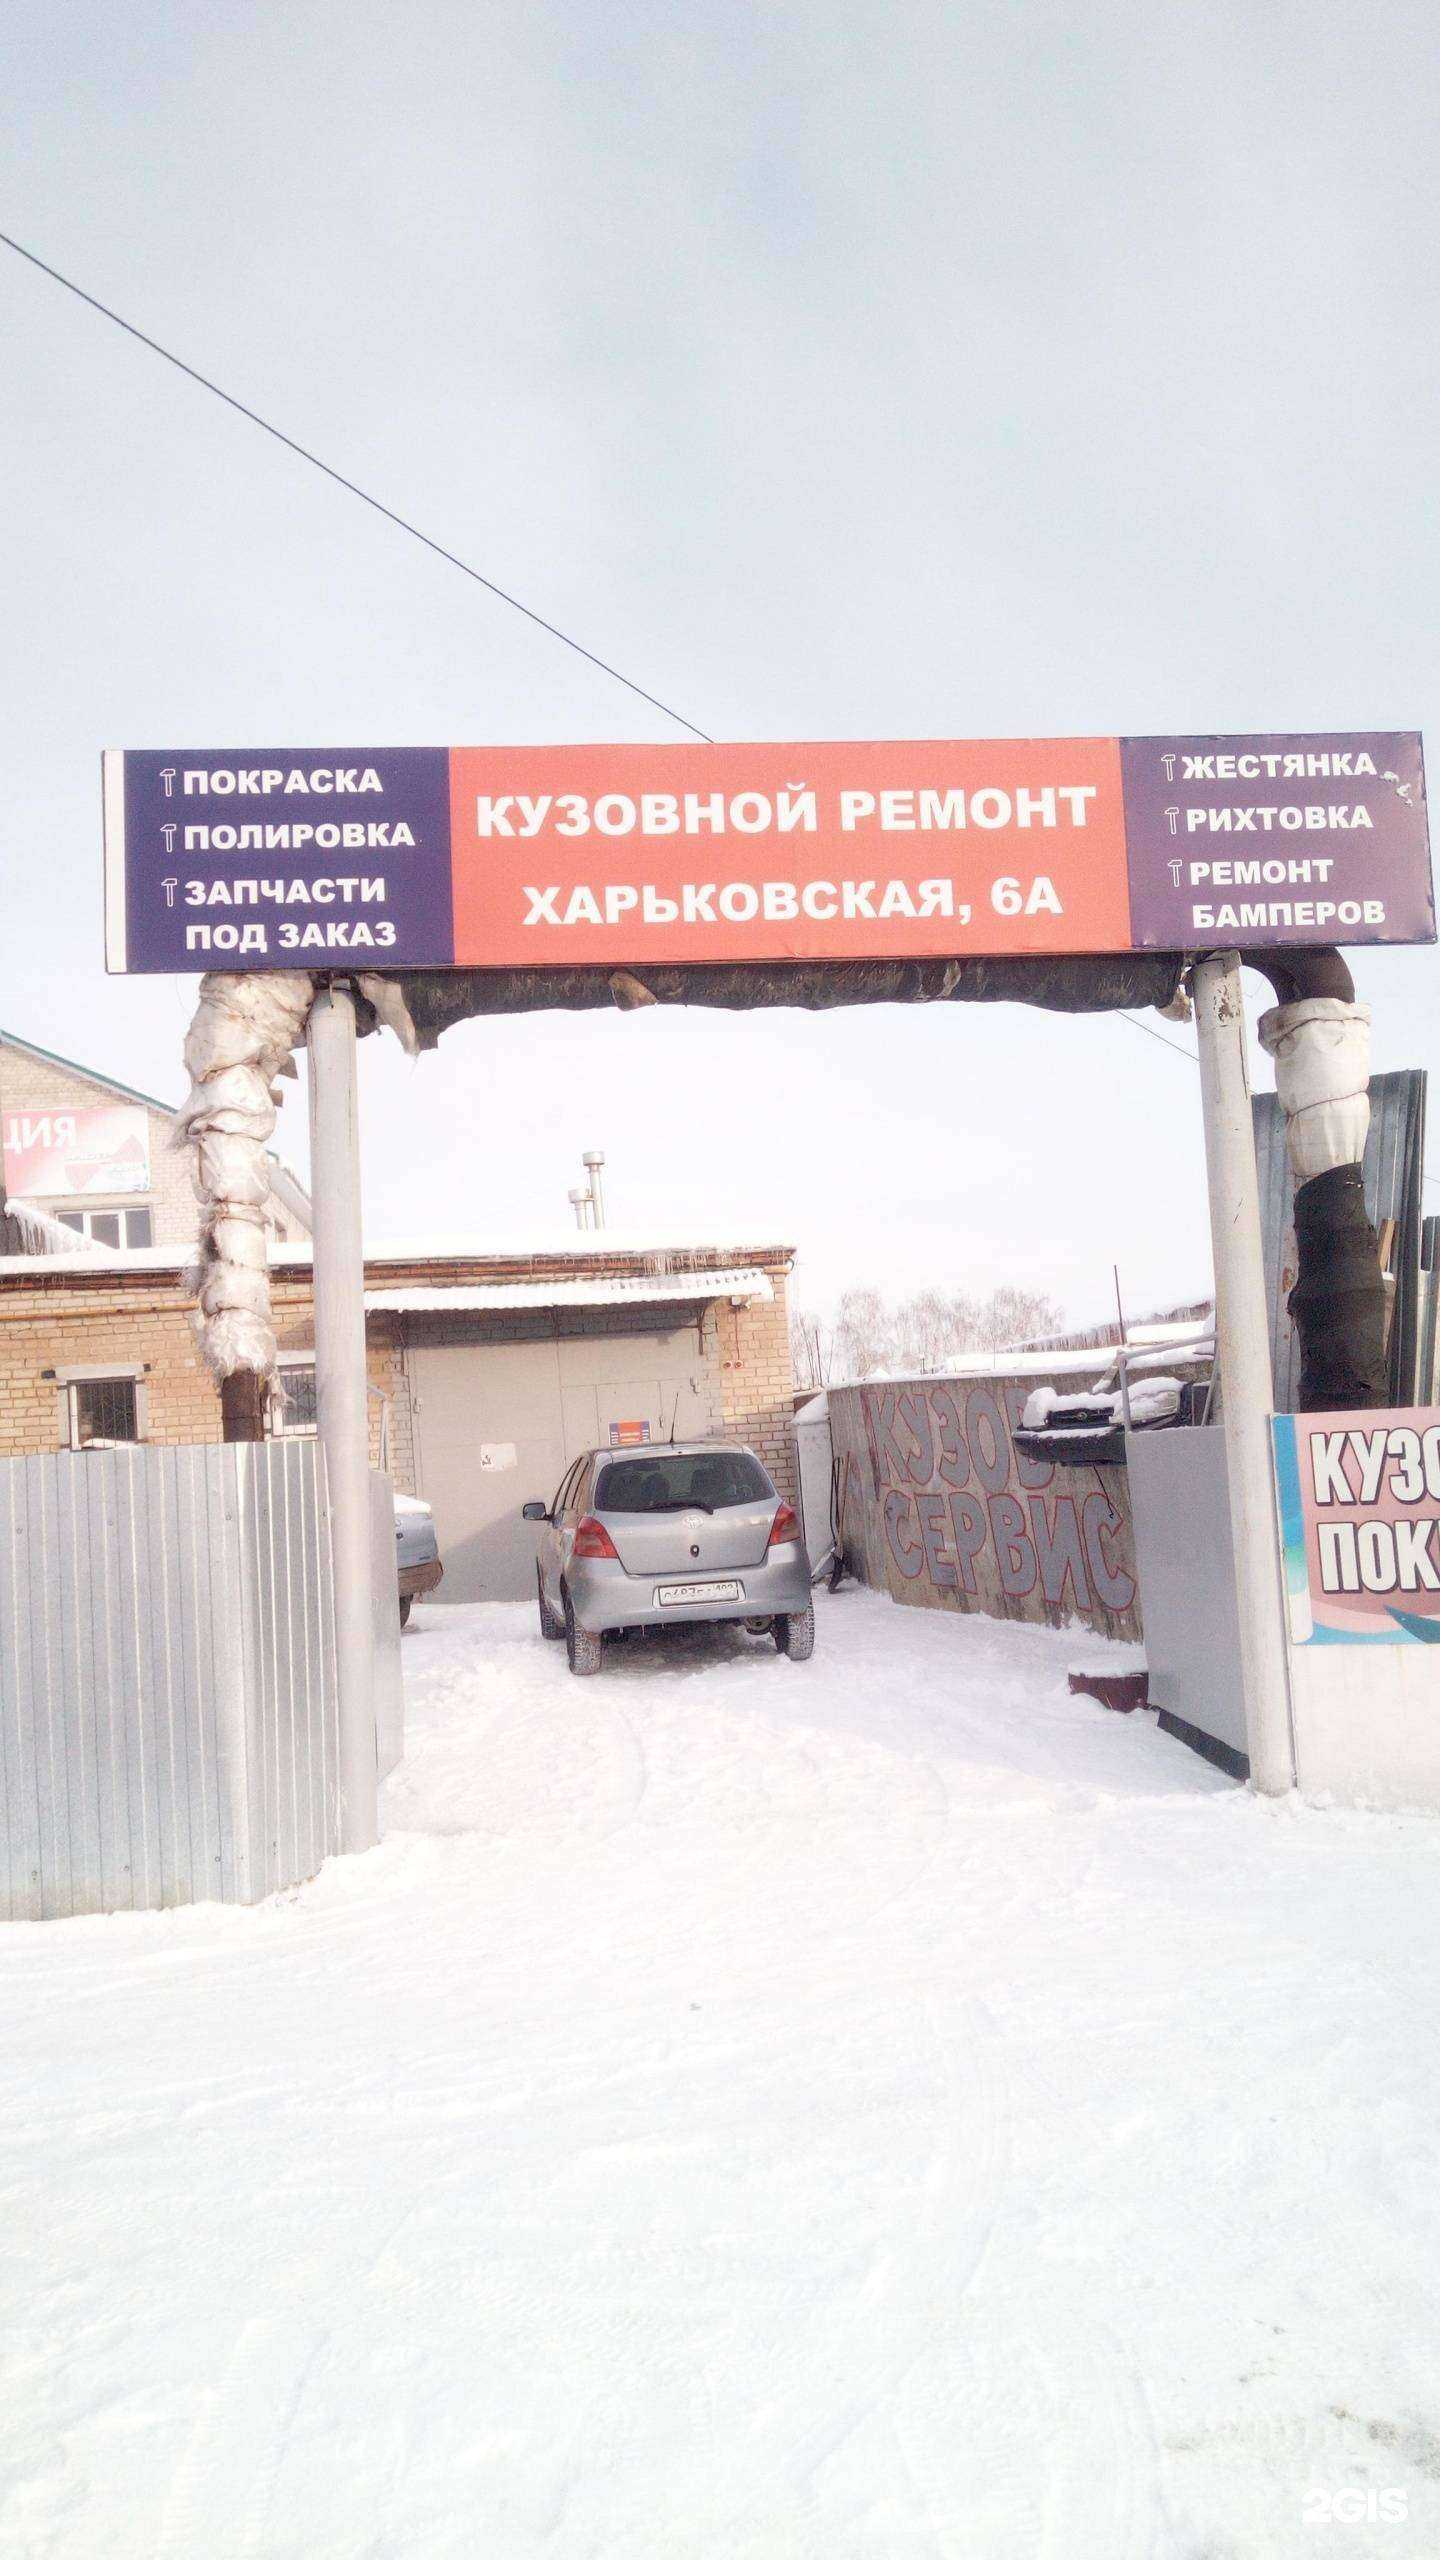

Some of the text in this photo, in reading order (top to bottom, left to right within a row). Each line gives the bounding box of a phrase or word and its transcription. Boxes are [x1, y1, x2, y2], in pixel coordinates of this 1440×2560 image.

[1181, 752, 1378, 780] ЖЕСТЯНКА
[183, 768, 384, 796] ПОКРАСКА
[475, 782, 1098, 838] КУЗОВНОЙ РЕМОНТ
[1186, 804, 1375, 832] РИХТОВКА
[184, 822, 416, 850] ПОЛИРОВКА
[1189, 858, 1334, 886] РЕМОНТ
[184, 877, 387, 906] ЗАПЧАСТИ
[522, 876, 1064, 926] ХАРЬКОВСКАЯ, 6А
[1192, 900, 1387, 929] БАМПЕРОВ
[186, 921, 397, 953] ПОД ЗАКАЗ
[884, 1490, 1138, 1612] СЕРВИС
[1316, 1519, 1440, 1594] ПОК
